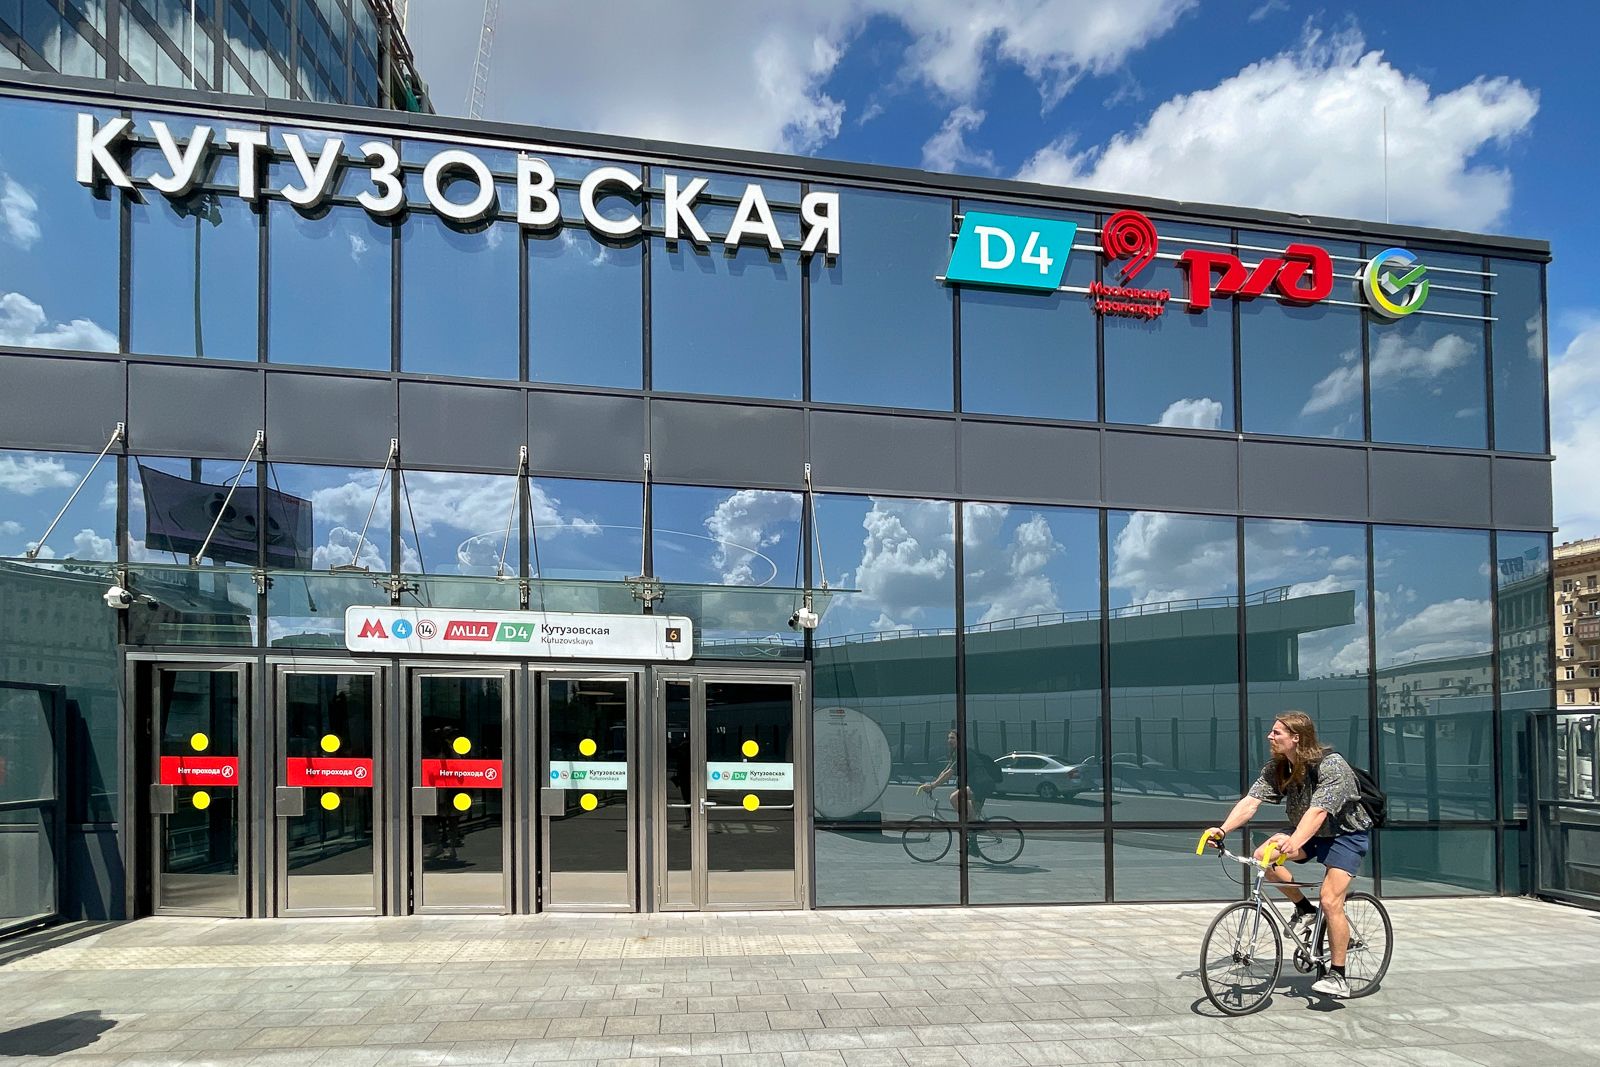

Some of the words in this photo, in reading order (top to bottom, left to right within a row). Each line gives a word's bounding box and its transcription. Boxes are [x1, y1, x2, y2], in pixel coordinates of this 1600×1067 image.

[76, 112, 842, 256] КУТУЗОВСКАЯ
[973, 225, 1054, 275] D4
[503, 625, 529, 640] D4
[541, 623, 611, 638] Кутузовская
[669, 630, 678, 641] 6
[541, 635, 594, 646] Kutuzovskaya
[177, 767, 191, 775] Нет
[192, 767, 221, 777] прохода
[305, 768, 320, 776] Нет
[321, 768, 353, 778] прохода
[439, 769, 453, 777] Нет
[454, 770, 484, 780] прохода
